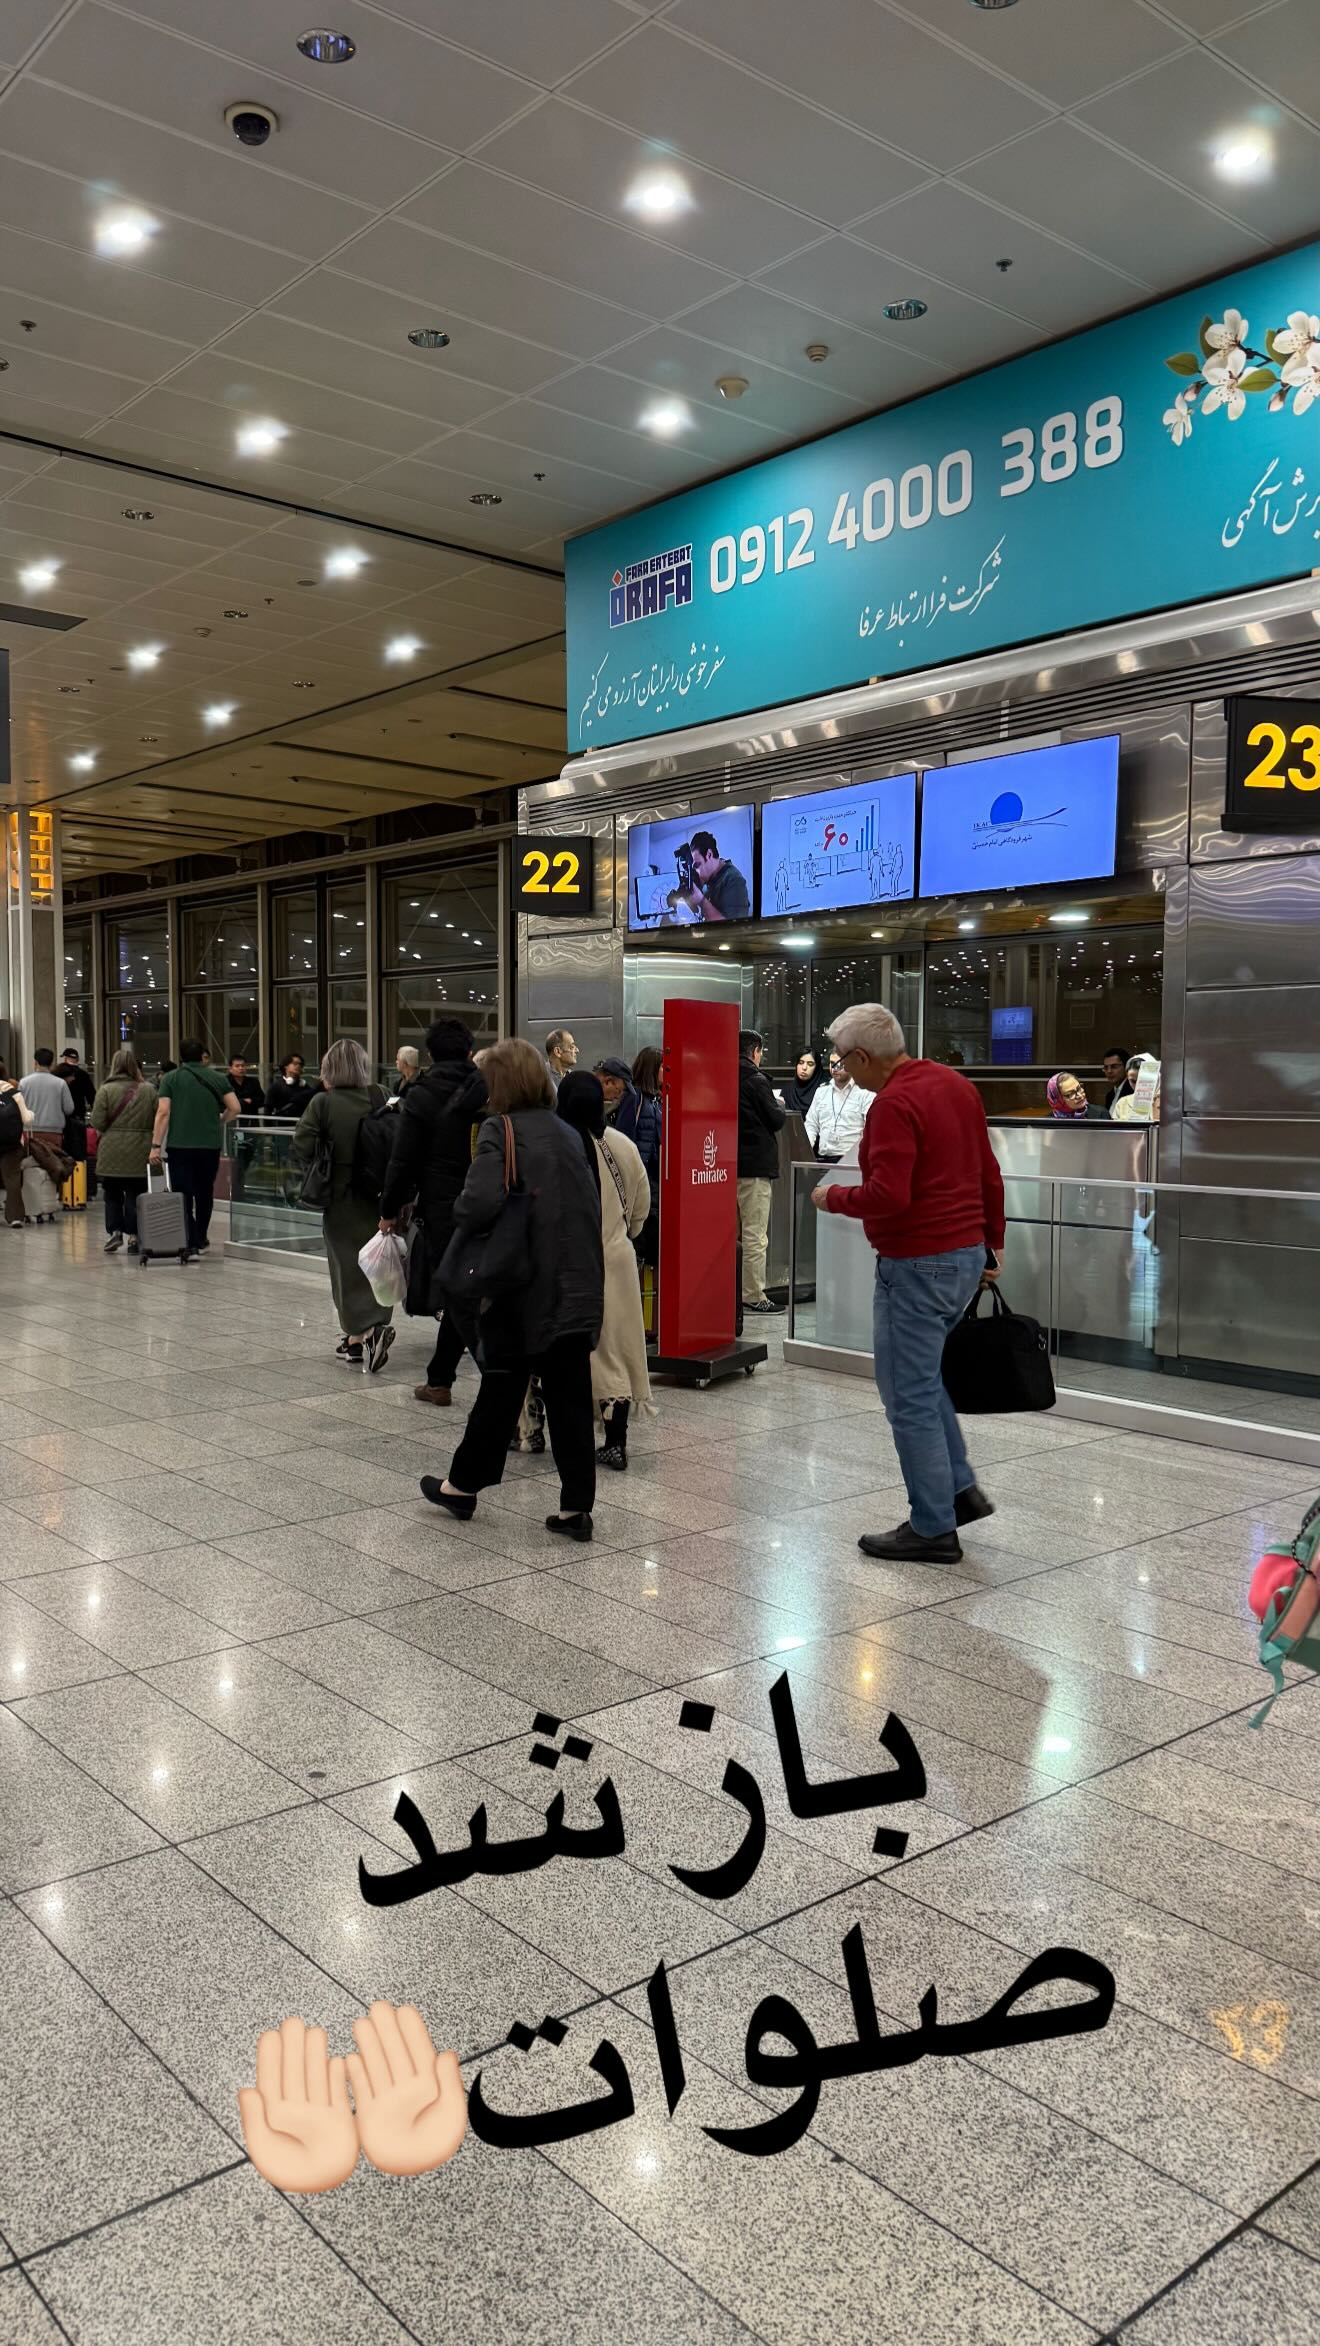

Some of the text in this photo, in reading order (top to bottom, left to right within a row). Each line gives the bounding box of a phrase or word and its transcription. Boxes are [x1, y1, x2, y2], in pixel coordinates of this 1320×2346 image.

[710, 395, 1124, 595] 0912 4000 388
[1221, 456, 1283, 548] آگهی
[625, 544, 692, 582] FARA ERTEBAT
[859, 533, 1006, 648] شرکت فرا ارتباط عرفا
[610, 560, 693, 628] ORAFA
[612, 669, 643, 706] آرزو
[679, 641, 708, 696] خوشی
[704, 645, 727, 690] سفر
[579, 651, 610, 741] کنیم
[597, 685, 612, 717] می
[1243, 722, 1320, 791] 23
[521, 850, 580, 894] 22
[691, 1167, 728, 1185] Emirates
